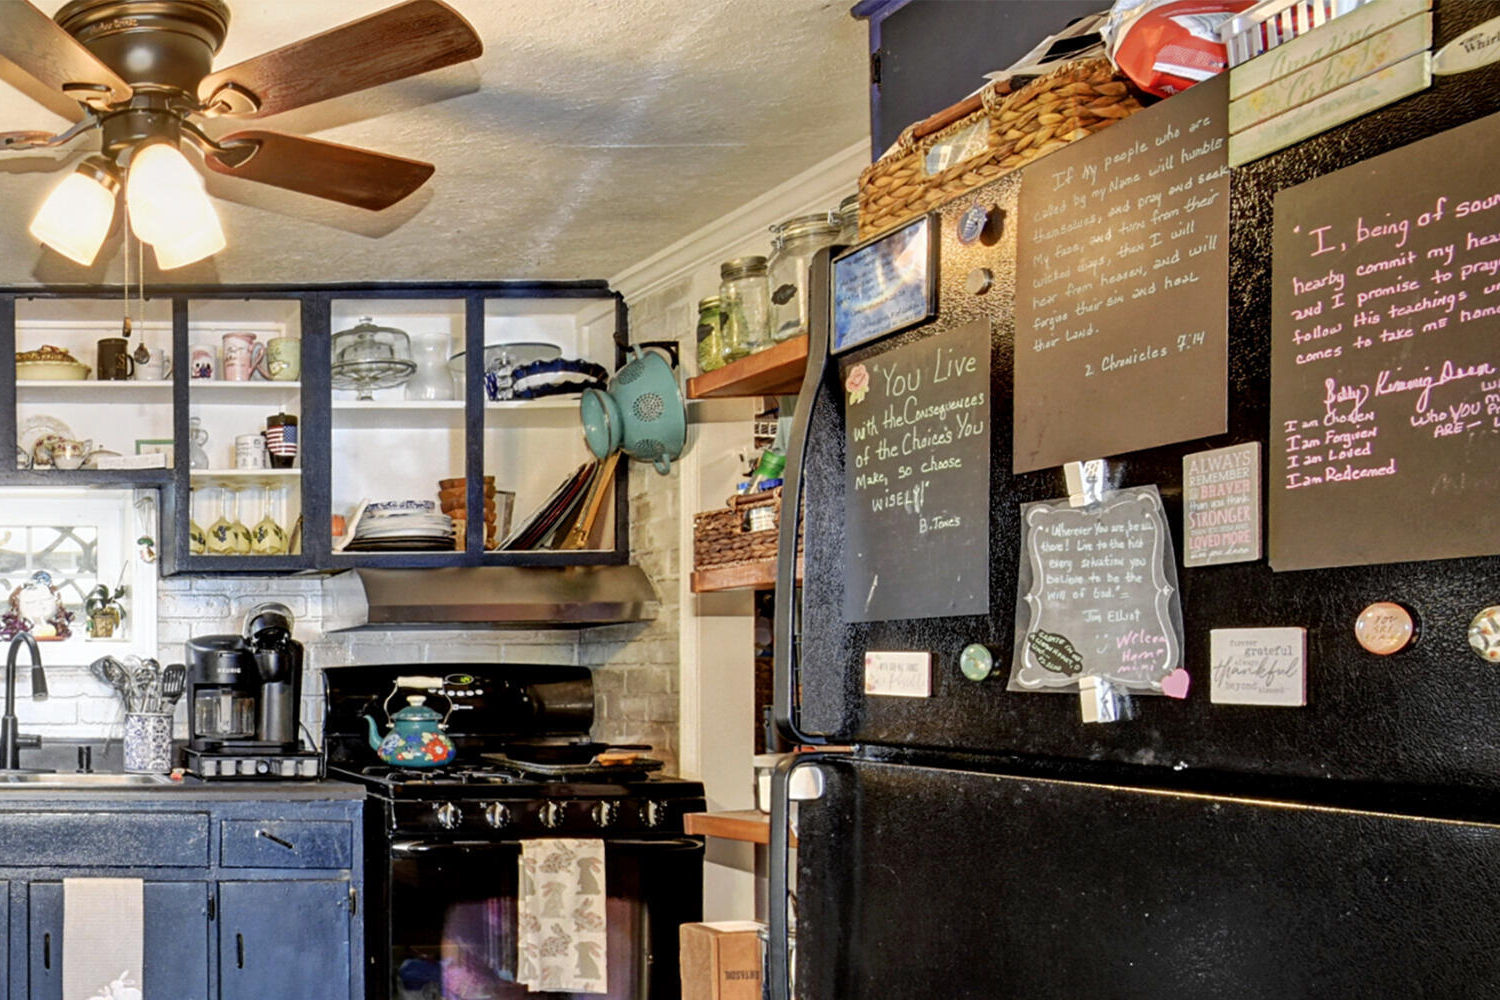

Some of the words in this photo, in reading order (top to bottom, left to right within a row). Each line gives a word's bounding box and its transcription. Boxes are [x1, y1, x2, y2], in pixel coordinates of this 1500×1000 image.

[1052, 167, 1074, 191] If
[1104, 142, 1148, 171] people
[1155, 124, 1180, 147] who
[1188, 116, 1211, 132] are
[1149, 157, 1174, 176] will
[1108, 199, 1130, 216] and
[1138, 192, 1162, 210] pray
[1169, 179, 1193, 195] and
[1198, 167, 1230, 184] seek
[1090, 228, 1112, 243] and
[1150, 208, 1179, 224] from
[1184, 189, 1219, 212] their
[1357, 213, 1409, 248] being
[1417, 196, 1447, 227] of
[1150, 232, 1162, 248] I
[1171, 220, 1194, 239] will
[1153, 252, 1180, 269] and
[1189, 234, 1217, 257] will
[1293, 270, 1345, 295] hearby
[1356, 251, 1417, 276] commit
[1427, 244, 1454, 265] my
[1132, 283, 1156, 299] and
[1291, 301, 1322, 320] and
[1332, 293, 1345, 309] I
[1357, 275, 1420, 307] promise
[1431, 270, 1452, 283] to
[1293, 323, 1342, 344] follow
[1354, 311, 1380, 327] His
[1388, 290, 1468, 318] teachings
[1296, 346, 1342, 364] comes
[1353, 336, 1372, 349] to
[1380, 327, 1414, 342] take
[1085, 365, 1093, 376] 2
[1101, 346, 1167, 371] Chronicles
[854, 416, 878, 442] with
[883, 404, 904, 427] the
[1284, 421, 1298, 432] I
[1302, 419, 1319, 428] am
[1324, 411, 1375, 426] Chosen
[856, 446, 870, 468] of
[876, 438, 898, 460] the
[957, 412, 983, 439] You
[1286, 435, 1301, 451] I
[1302, 438, 1320, 449] am
[1325, 426, 1377, 448] Forgiven
[921, 455, 962, 473] choose
[1188, 450, 1251, 475] ALWAYS
[1287, 455, 1299, 469] I
[1303, 455, 1322, 465] am
[1329, 442, 1372, 460] Loved
[1189, 467, 1250, 487] REMEMBER
[1201, 480, 1250, 499] BRAVER
[1286, 473, 1301, 489] I
[1303, 475, 1322, 486] am
[1189, 506, 1251, 529] STRONGER
[1189, 534, 1220, 550] LOVED
[1222, 530, 1251, 546] MORE
[1107, 573, 1120, 583] be
[1125, 572, 1142, 583] the
[1130, 559, 1146, 571] you
[1073, 588, 1086, 598] of
[1245, 645, 1292, 657] grateful
[1213, 656, 1299, 687] thankful
